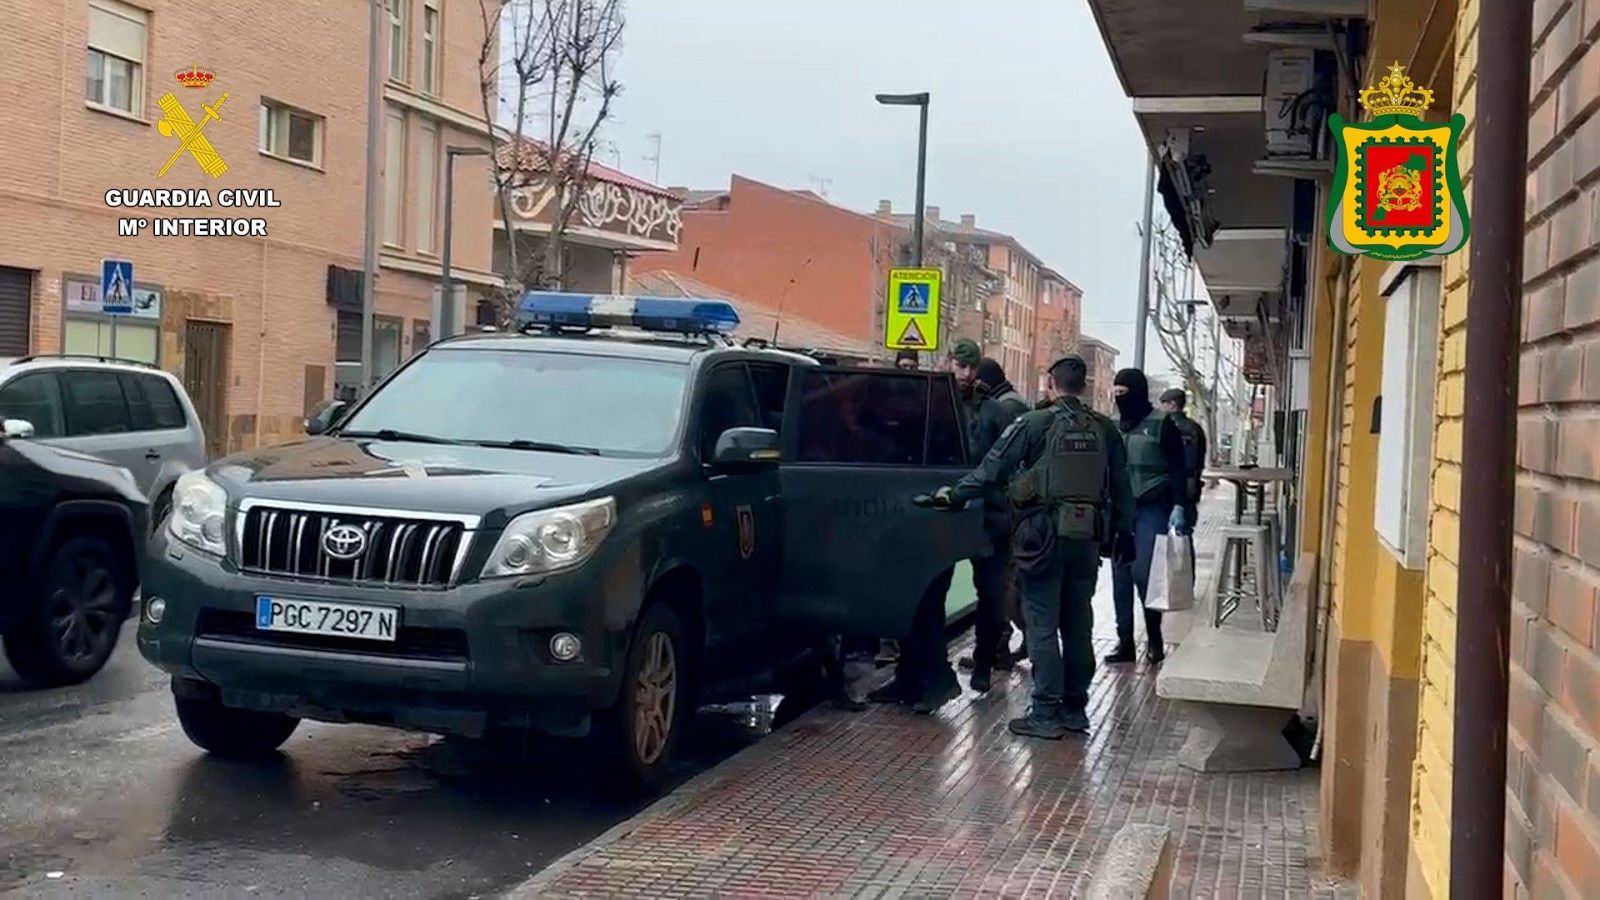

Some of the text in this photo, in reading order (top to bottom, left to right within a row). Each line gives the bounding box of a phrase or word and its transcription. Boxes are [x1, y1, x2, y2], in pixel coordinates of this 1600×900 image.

[271, 602, 392, 637] PGC 7297 N
